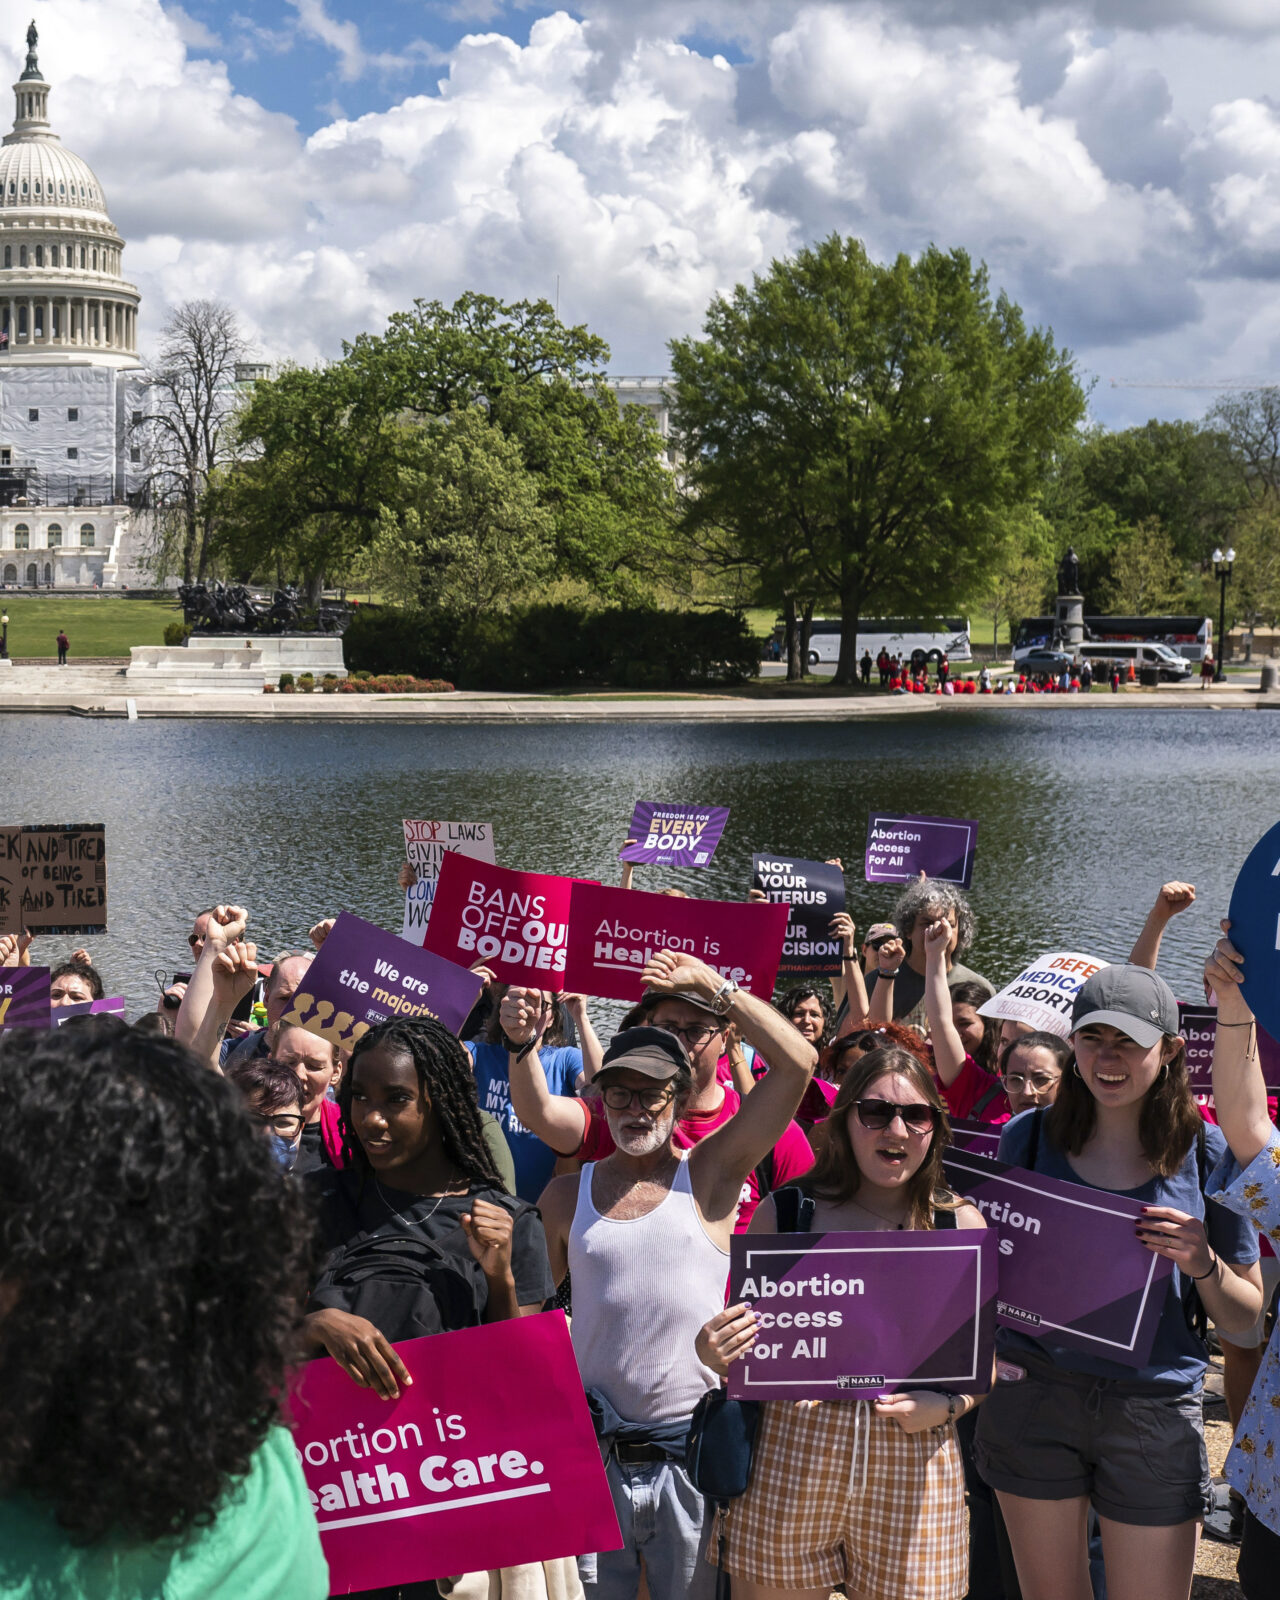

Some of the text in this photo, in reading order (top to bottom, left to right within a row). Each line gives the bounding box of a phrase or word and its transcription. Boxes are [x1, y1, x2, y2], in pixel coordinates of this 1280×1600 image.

[652, 811, 686, 820] FREEDOM
[405, 820, 486, 841] STOP LAWS
[649, 818, 708, 836] EVERY
[870, 829, 922, 842] Abortion
[21, 836, 60, 862] AND
[643, 833, 703, 851] BODY
[869, 842, 911, 854] Access
[758, 860, 794, 873] NOT
[868, 855, 904, 866] For All
[42, 865, 84, 881] BEING
[758, 874, 808, 889] YOUR
[22, 885, 55, 909] AND
[55, 884, 106, 909] TIRED
[467, 880, 547, 920] BANS
[461, 905, 569, 947] OFF OU
[594, 919, 721, 956] Abortion is
[456, 926, 568, 972] BODIES
[781, 941, 840, 956] CISION
[373, 958, 430, 996] We are
[1048, 957, 1100, 979] DEFE
[339, 969, 370, 994] the
[1019, 970, 1084, 994] MEDICA
[1178, 1028, 1217, 1041] Abor
[488, 1078, 510, 1096] MY
[485, 1092, 509, 1111] MY
[739, 1273, 865, 1298] Abortion
[1008, 1306, 1038, 1322] NARAL
[791, 1336, 827, 1359] All
[851, 1377, 883, 1385] NARAL
[432, 1407, 467, 1443] is
[419, 1449, 545, 1493] Care.
